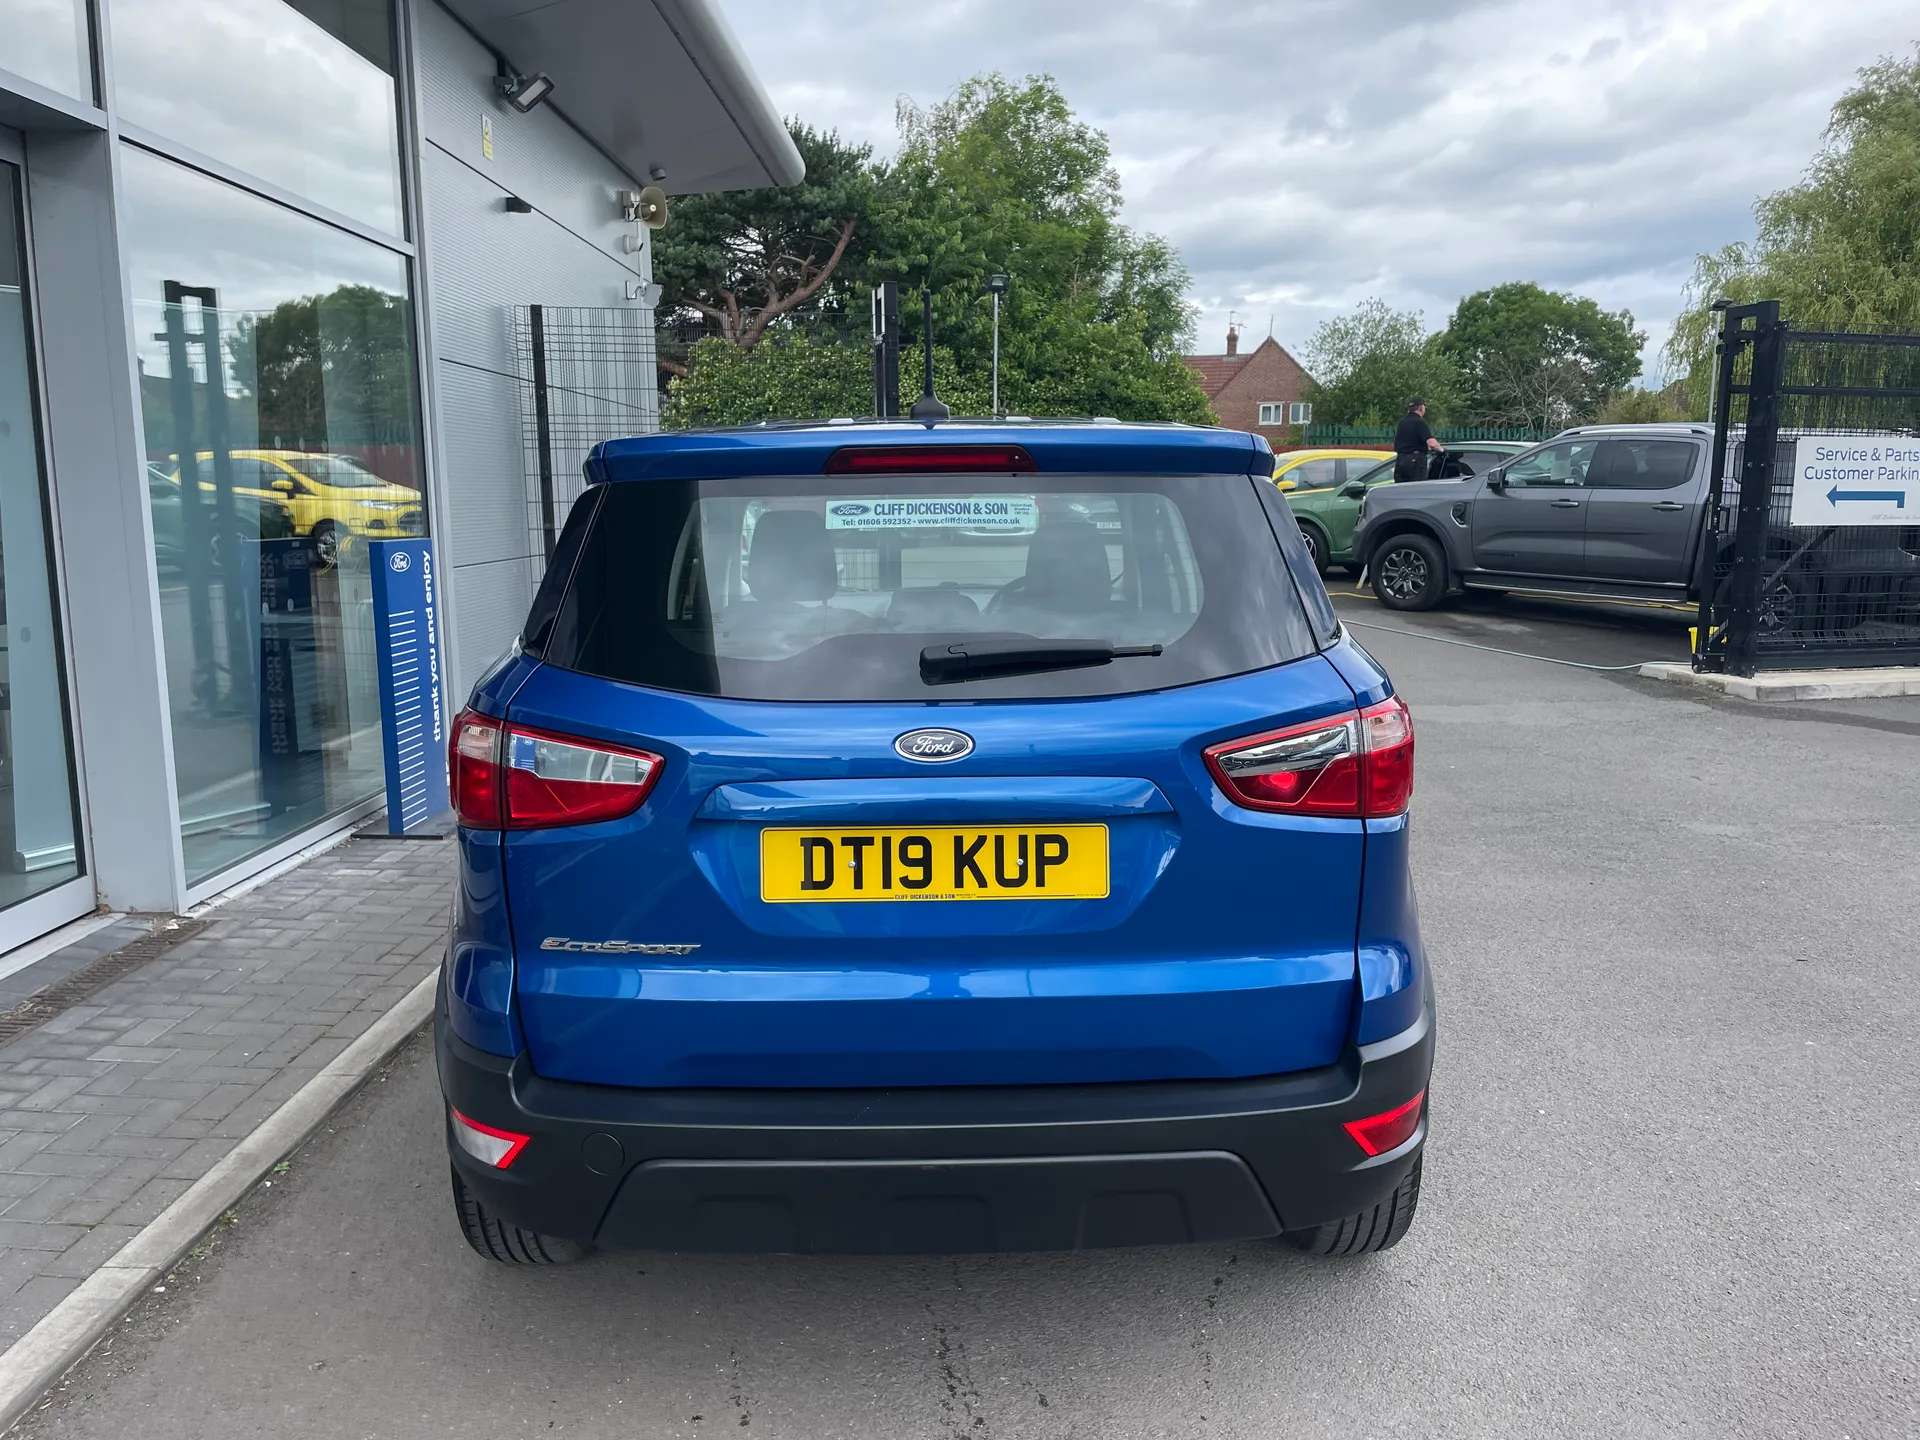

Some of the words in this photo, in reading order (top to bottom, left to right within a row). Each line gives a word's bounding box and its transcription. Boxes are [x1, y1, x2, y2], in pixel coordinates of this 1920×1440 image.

[1815, 446, 1868, 461] Service
[1870, 447, 1881, 461] &
[1885, 447, 1920, 462] Parts
[1804, 466, 1874, 480] Customer
[1878, 466, 1920, 480] Parkin
[874, 503, 905, 516] CLIFF
[906, 503, 971, 515] DICKENSON
[973, 503, 983, 515] &
[984, 503, 1008, 515] SON
[918, 517, 1020, 525] www.cliffdickenson.co.uk
[423, 550, 432, 604] enjoy
[425, 606, 435, 645] and
[429, 647, 439, 681] you
[431, 685, 441, 743] thank
[912, 735, 955, 753] Ford
[800, 835, 933, 891] DT19
[953, 834, 1069, 889] KUP
